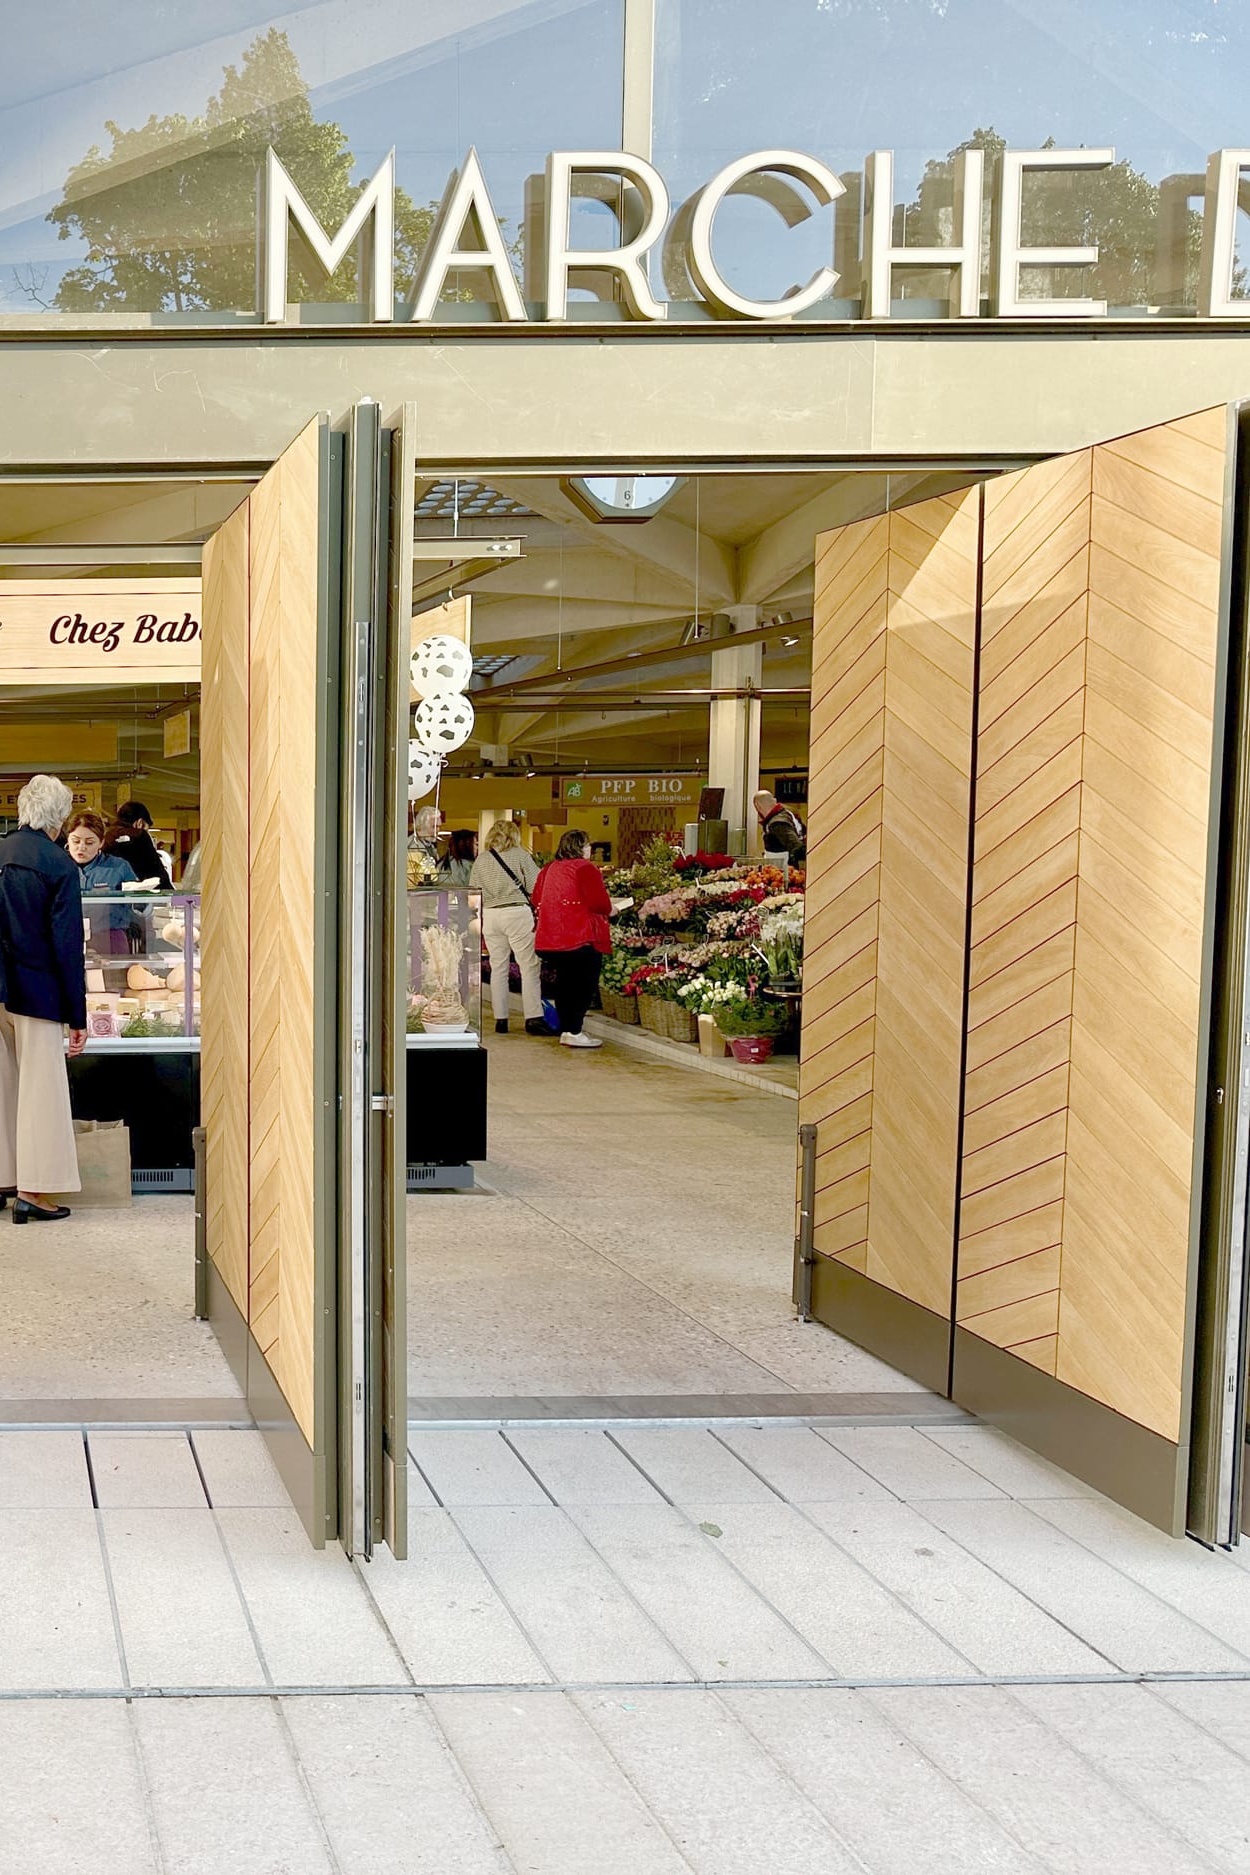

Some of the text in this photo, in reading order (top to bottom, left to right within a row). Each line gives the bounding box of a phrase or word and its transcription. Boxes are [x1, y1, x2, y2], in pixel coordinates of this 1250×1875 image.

[265, 144, 1115, 318] MARCHE
[624, 490, 631, 501] 6
[49, 612, 202, 652] Chez Bab
[600, 779, 683, 794] PFP BIO
[7, 795, 18, 804] E
[591, 794, 691, 803] Agriculture biologique
